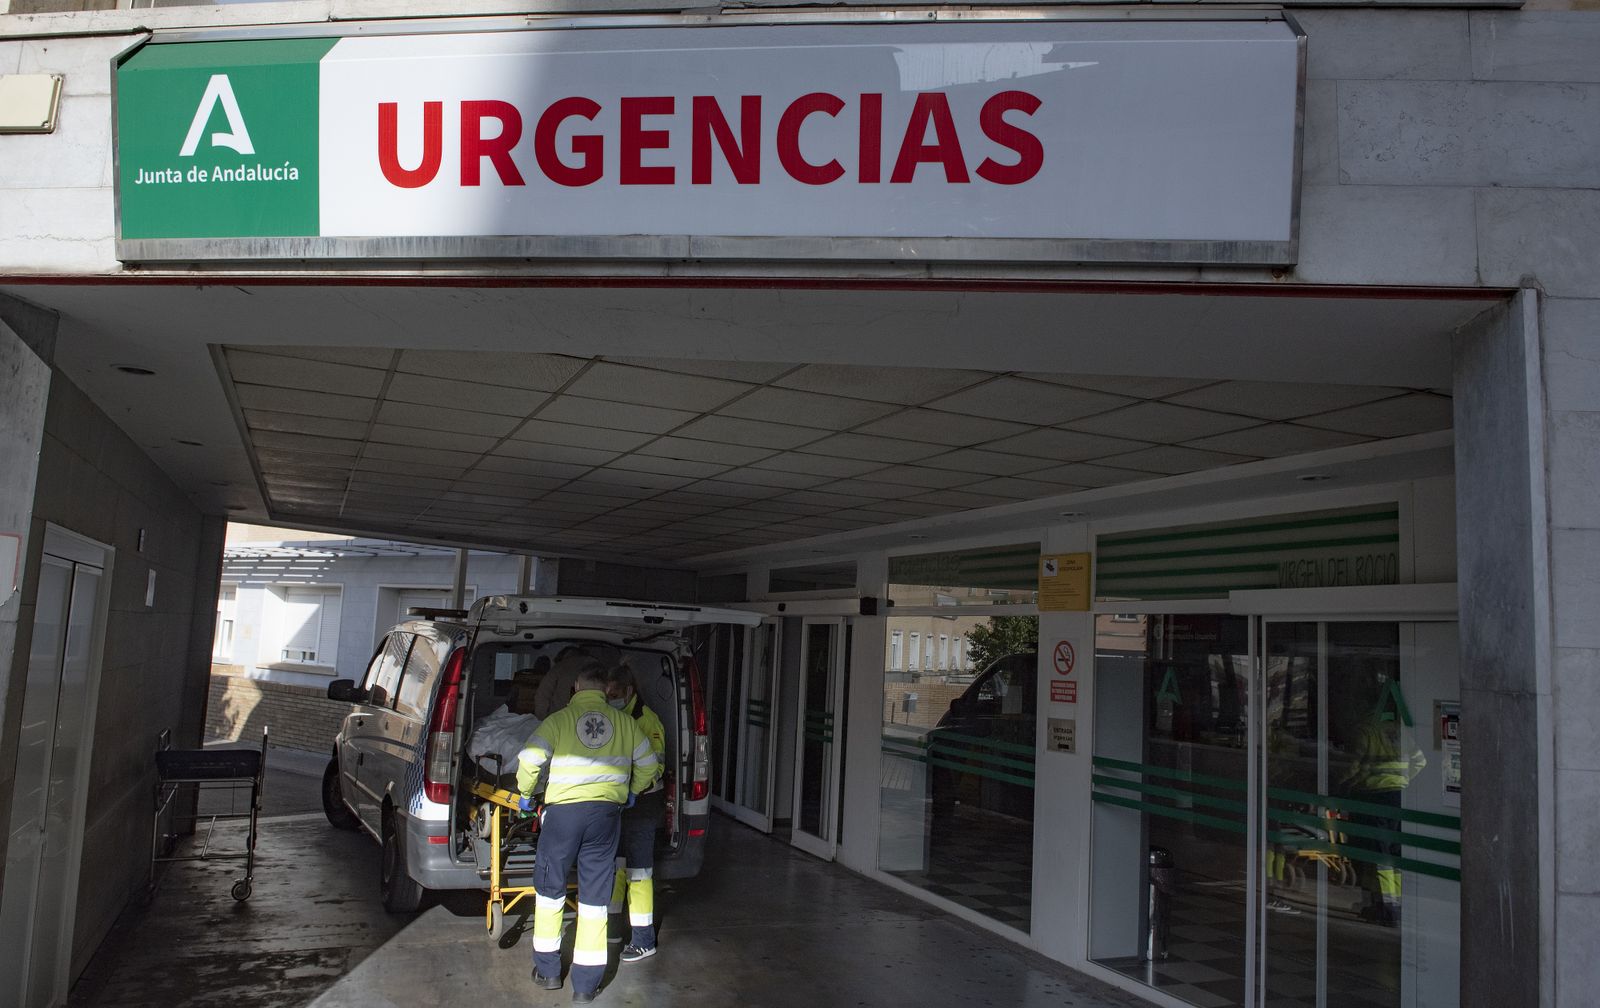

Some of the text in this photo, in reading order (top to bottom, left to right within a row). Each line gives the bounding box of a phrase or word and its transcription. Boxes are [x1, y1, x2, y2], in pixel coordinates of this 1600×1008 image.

[378, 91, 1045, 189] URGENCIAS
[134, 160, 300, 185] Junta de Andalucía
